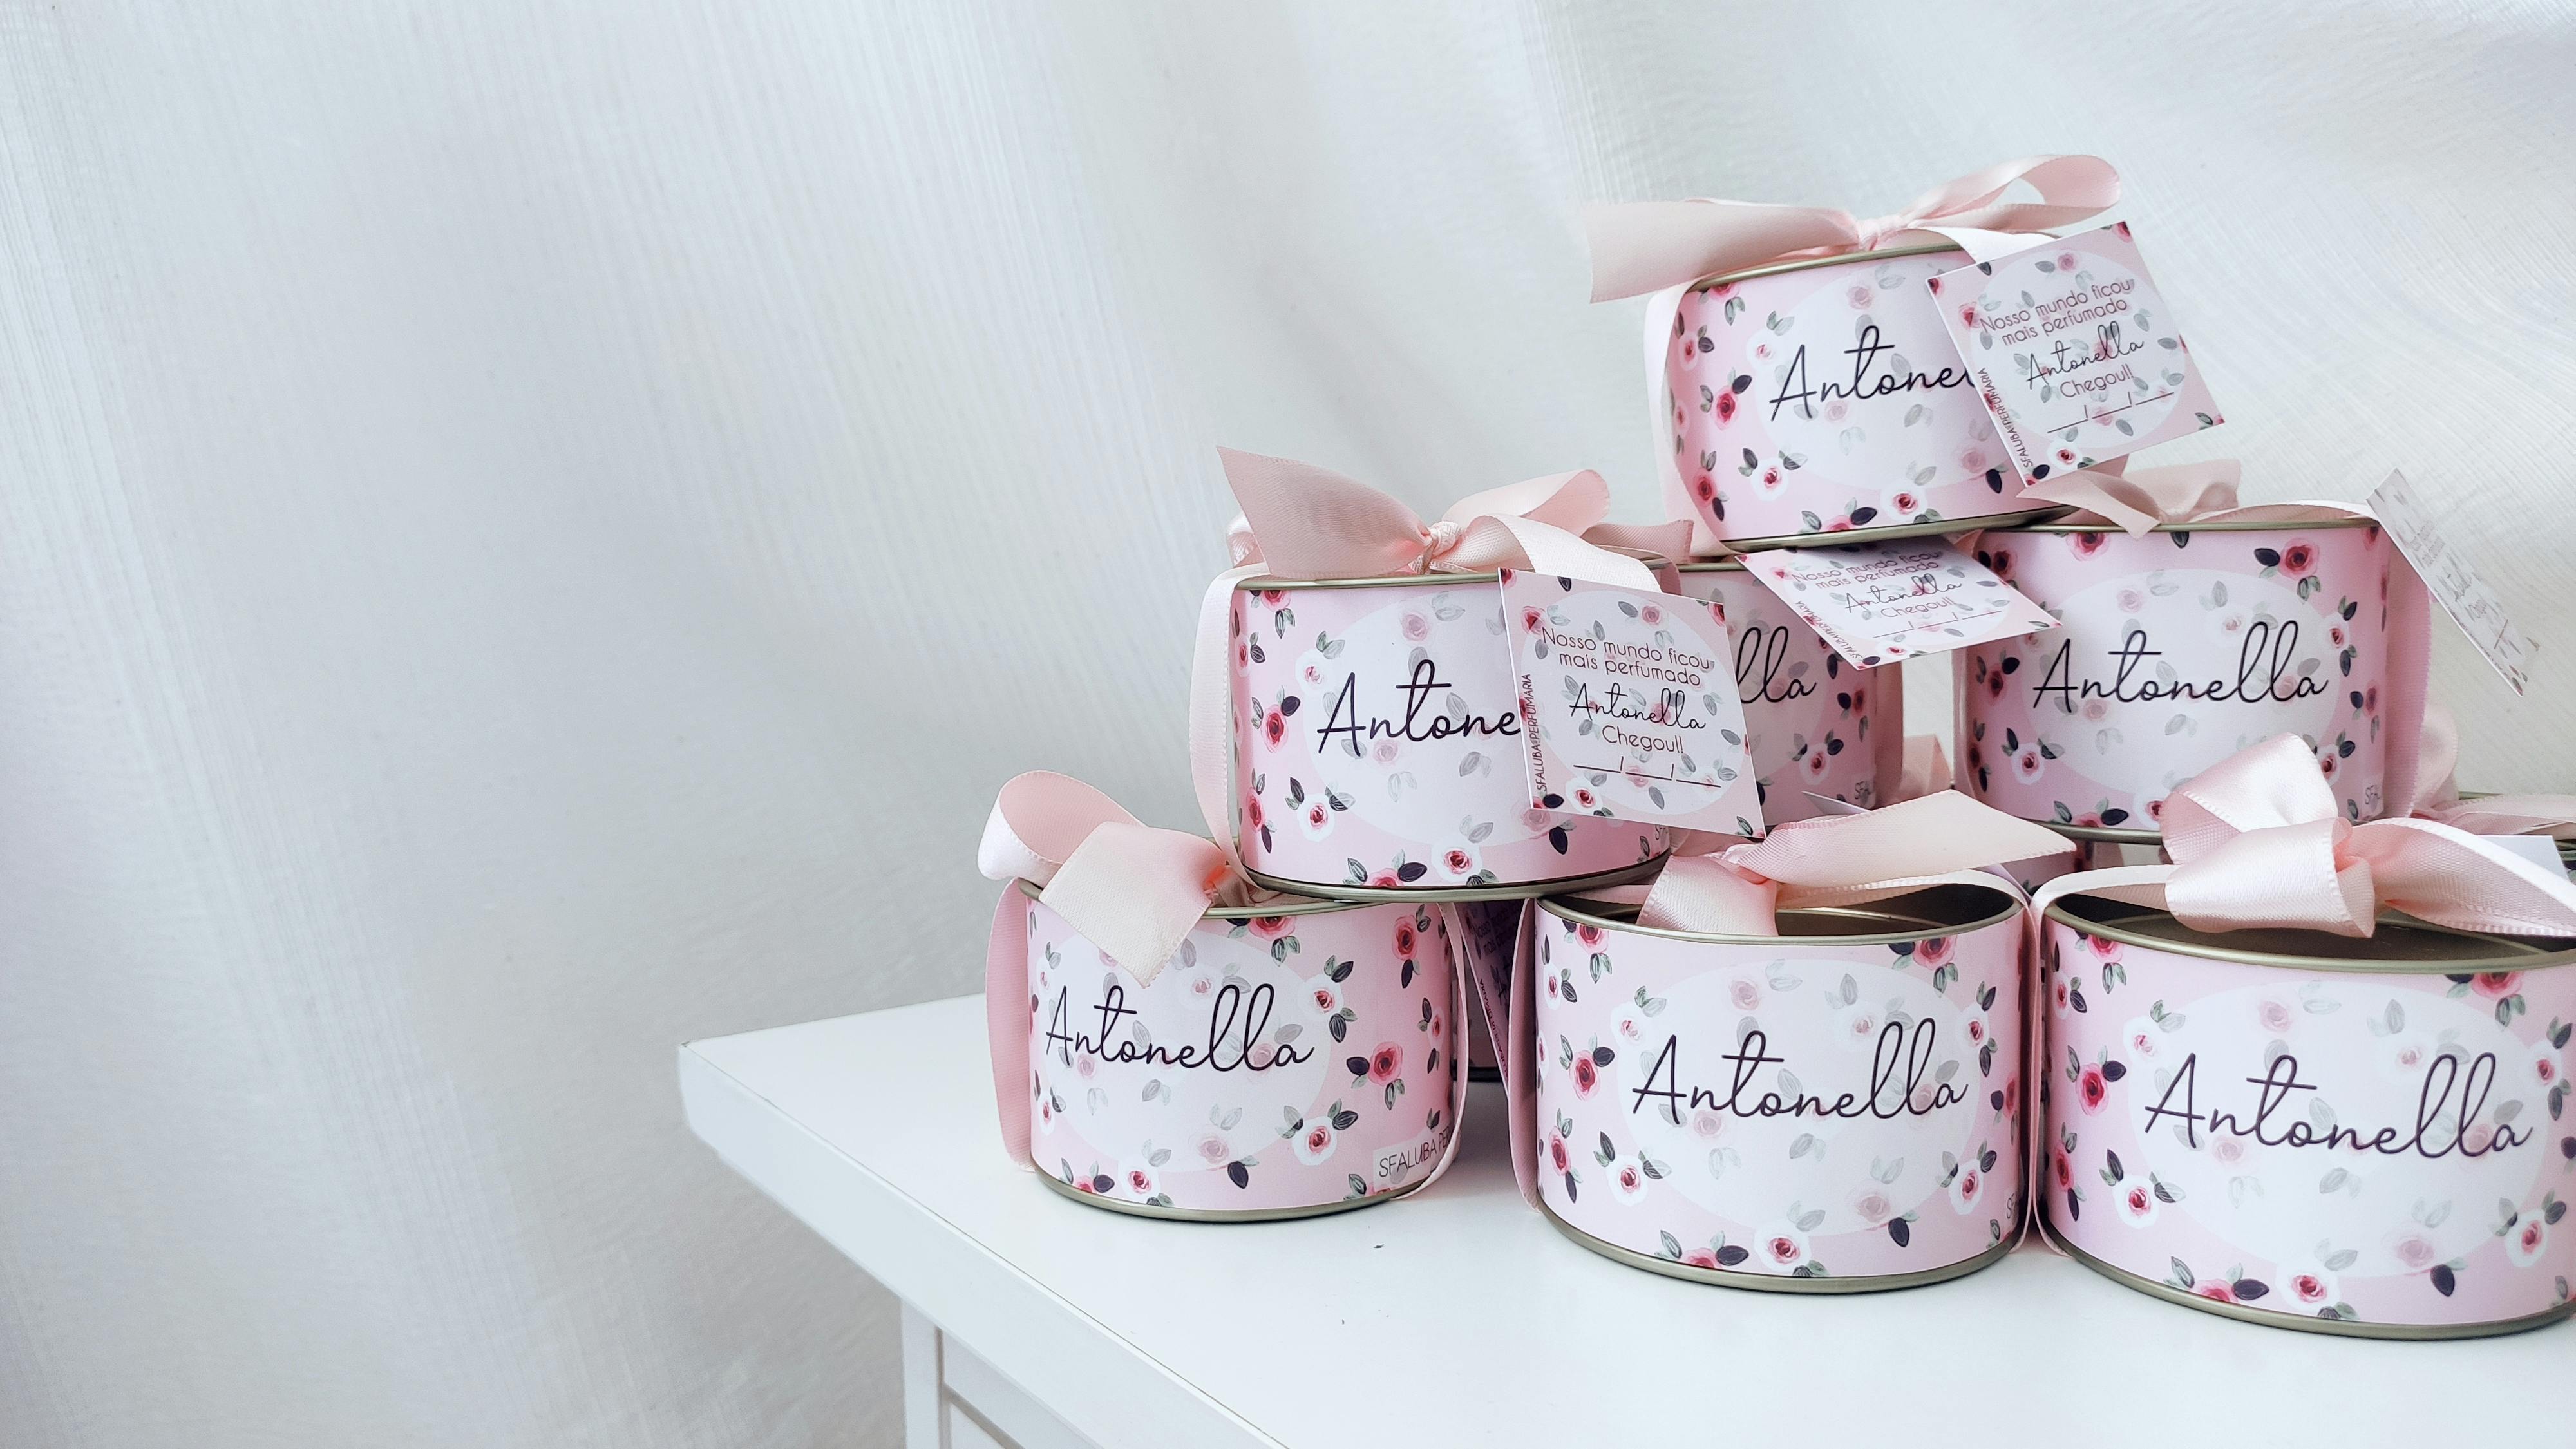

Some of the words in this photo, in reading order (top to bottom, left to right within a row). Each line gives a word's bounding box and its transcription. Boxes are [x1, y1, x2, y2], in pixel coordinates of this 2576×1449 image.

[1980, 310, 2031, 333] Nosso
[2035, 290, 2088, 317] mundo
[2091, 279, 2131, 299] ficou
[2002, 327, 2038, 346] mais
[2041, 298, 2128, 336] perfumado
[1769, 325, 1975, 422] Antone
[2026, 321, 2144, 390] Antonella
[1978, 367, 2012, 427] PERFUMARIA
[2060, 363, 2134, 397] Chegou!!
[2007, 428, 2033, 468] SFALUBA
[1792, 569, 1841, 582] Nosso
[1846, 559, 1897, 573] mundo
[1899, 551, 1940, 564] ficou
[1815, 578, 1851, 589] mais
[1854, 562, 1939, 583] perfumado
[1845, 573, 1962, 613] Antonella
[1542, 627, 1596, 650] Nosso
[1604, 641, 1662, 661] mundo
[1669, 648, 1709, 669] ficou
[1559, 653, 1598, 670] mais
[1605, 659, 1700, 686] perfumado
[2032, 620, 2329, 714] Antonella
[1521, 674, 1540, 740] PERFUMARIA
[1569, 683, 1706, 730] Antonella
[1602, 724, 1683, 753] Chegou!!
[1531, 744, 1547, 791] SFALUBA
[1046, 983, 1314, 1072] Antonella
[1631, 1018, 1969, 1124] Antonella
[2145, 1052, 2533, 1158] Antonella
[1379, 1139, 1437, 1177] SFALUBA
